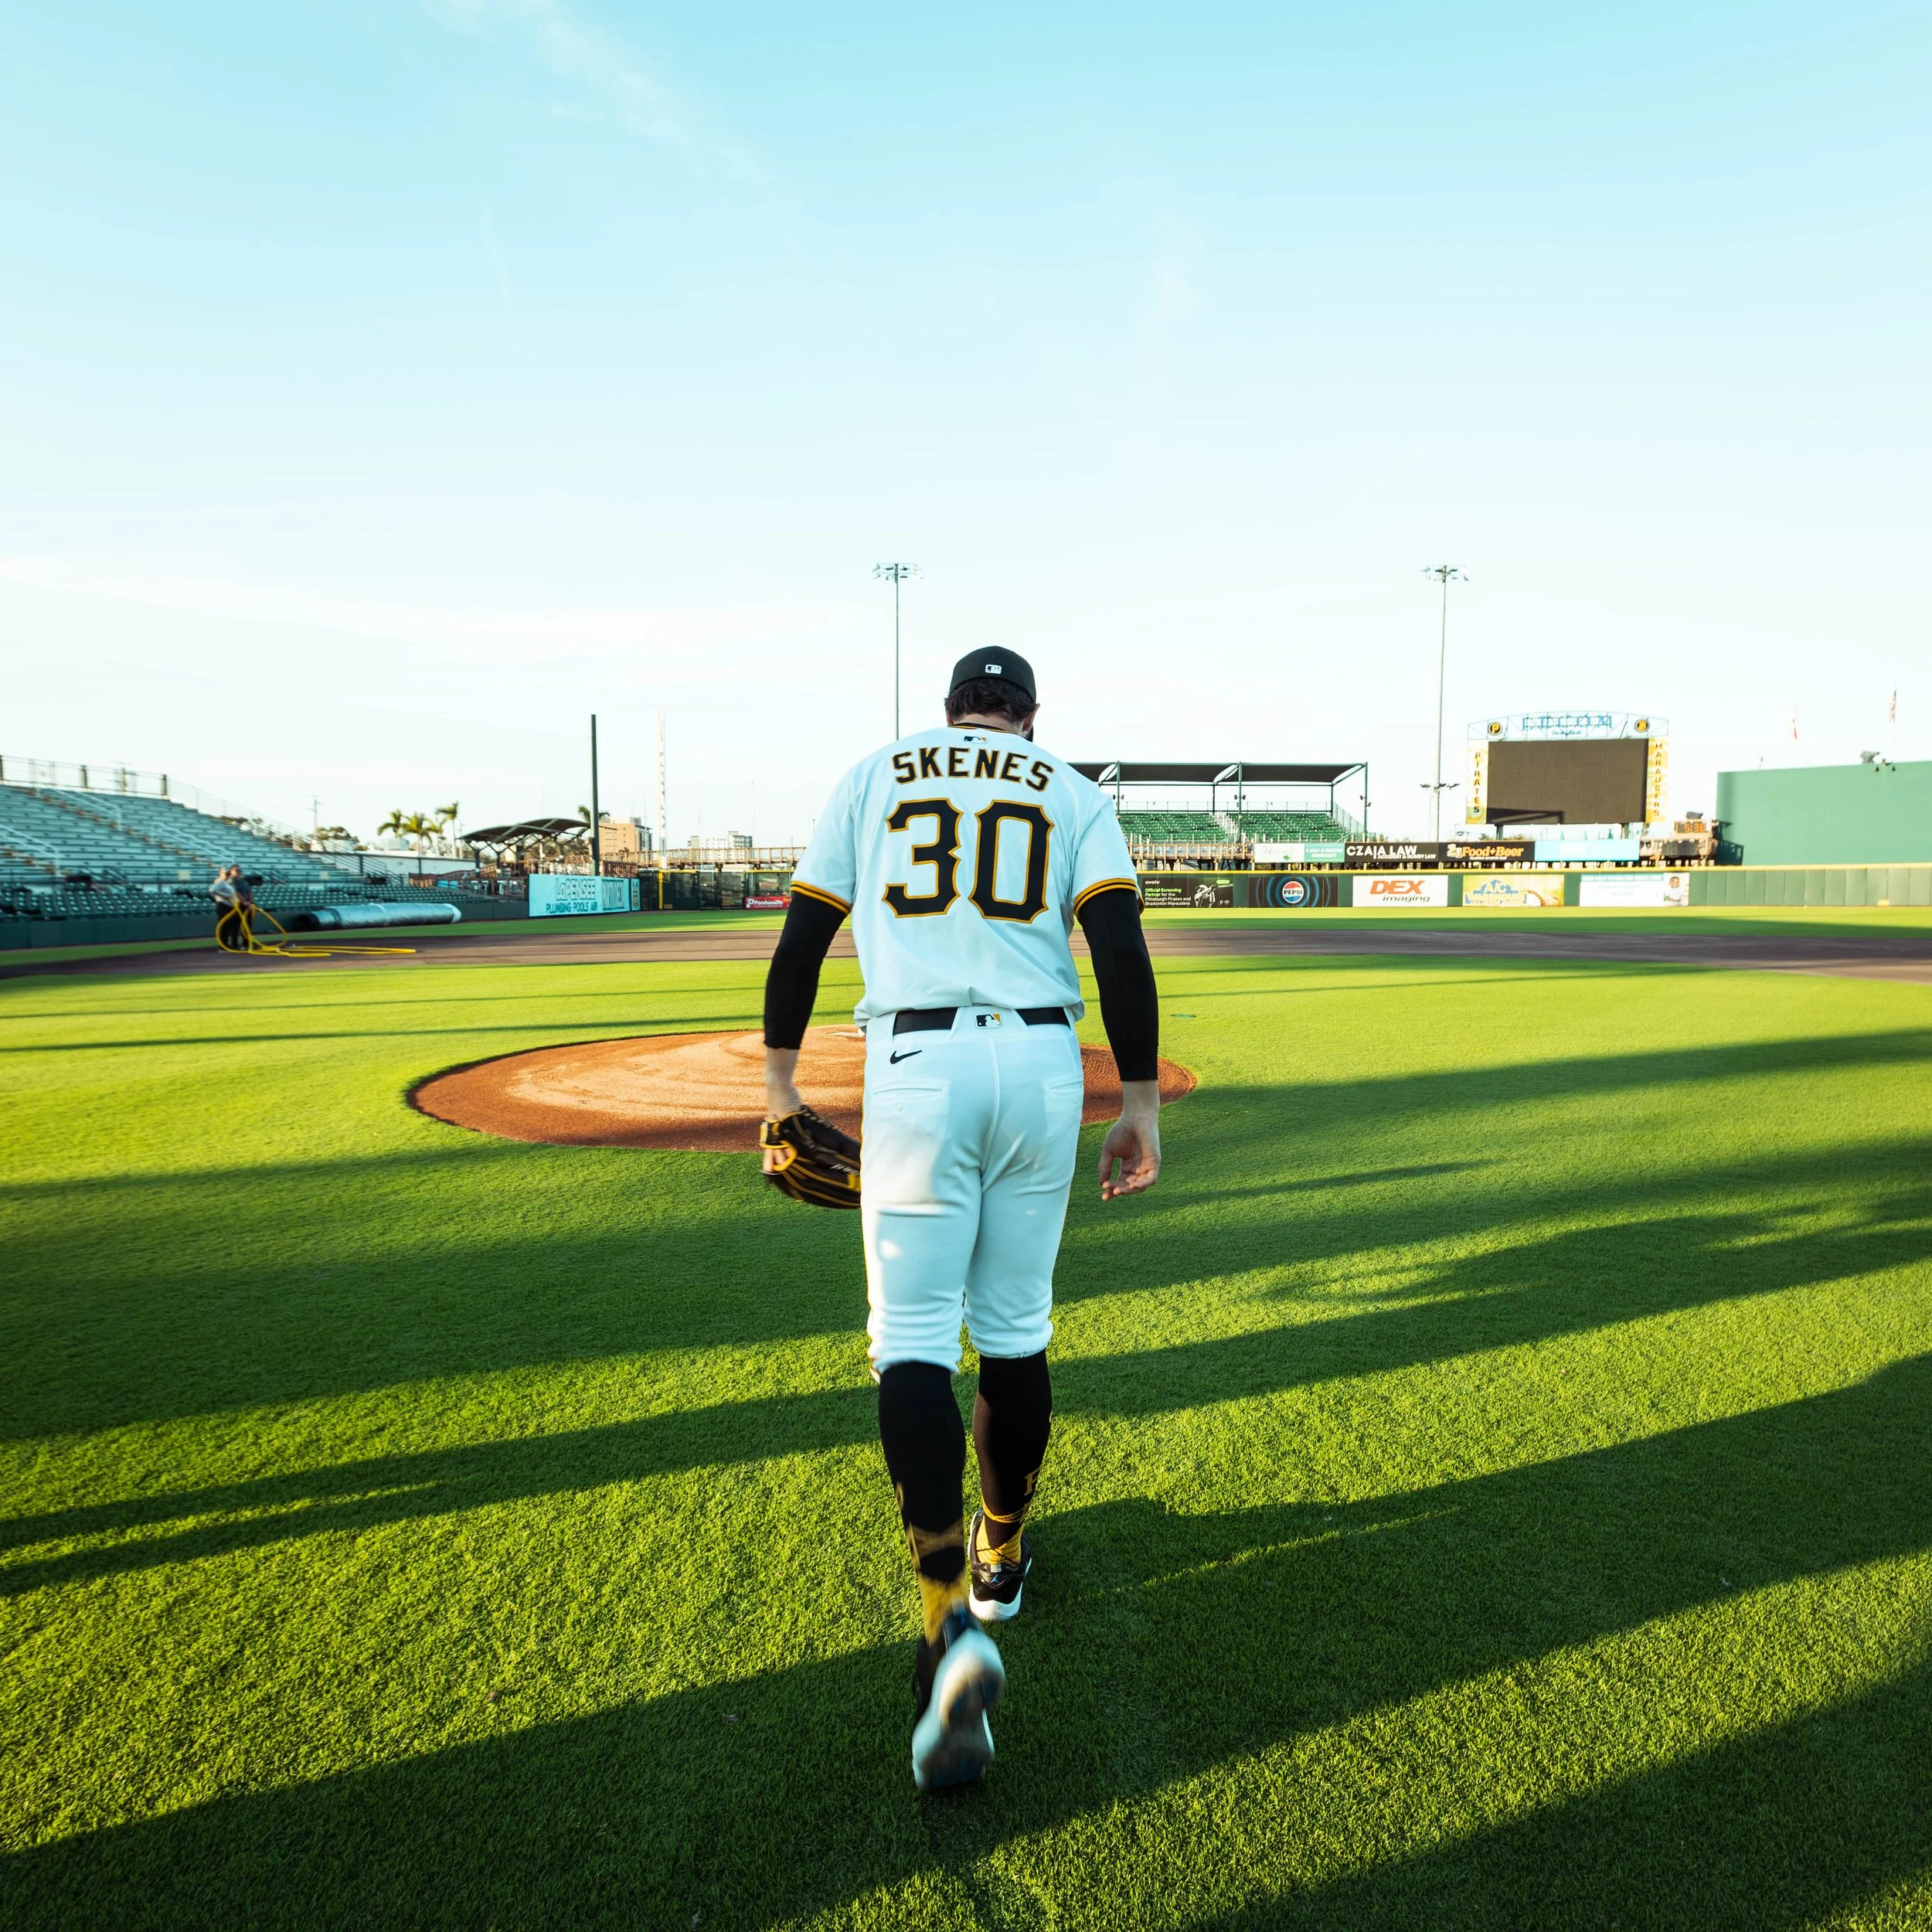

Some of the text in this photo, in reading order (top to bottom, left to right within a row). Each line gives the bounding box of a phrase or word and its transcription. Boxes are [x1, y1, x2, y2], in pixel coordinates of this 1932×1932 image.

[892, 747, 1055, 792] SKENES
[1683, 823, 1706, 833] 5:38
[1389, 845, 1417, 855] LAW
[881, 797, 1056, 924] 30
[556, 877, 596, 901] LaPENSEE
[1369, 880, 1425, 894] DEX
[546, 902, 572, 913] PLUMBING
[573, 902, 589, 912] POOLS
